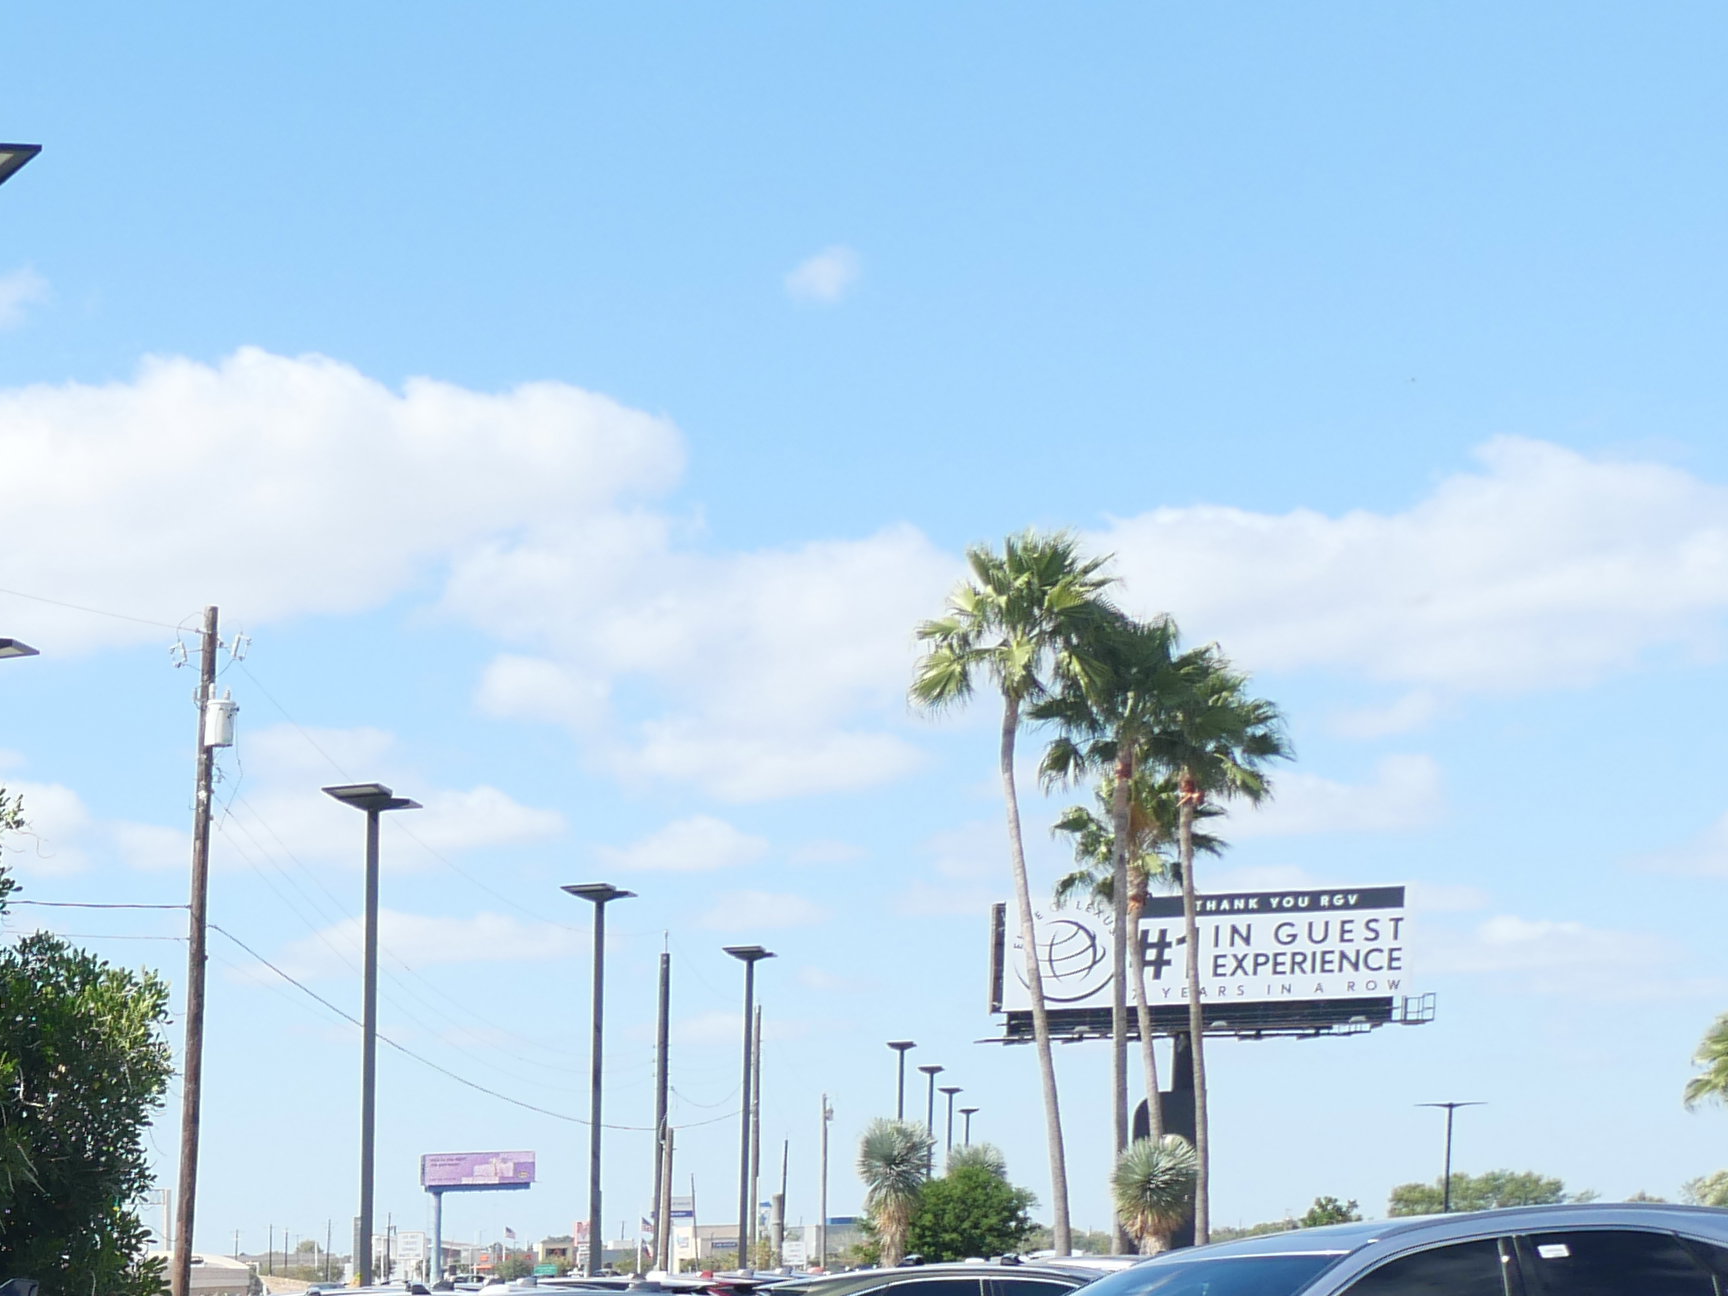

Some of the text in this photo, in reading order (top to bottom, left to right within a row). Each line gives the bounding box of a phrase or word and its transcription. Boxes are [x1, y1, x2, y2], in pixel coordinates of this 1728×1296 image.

[1194, 894, 1359, 911] THANK YOU RGV
[1213, 917, 1404, 948] IN GUEST
[1212, 947, 1403, 977] EXPERIENCE
[1162, 985, 1245, 998] YEARS
[1267, 983, 1292, 995] IN
[1314, 983, 1324, 994] A
[1347, 979, 1401, 992] ROW
